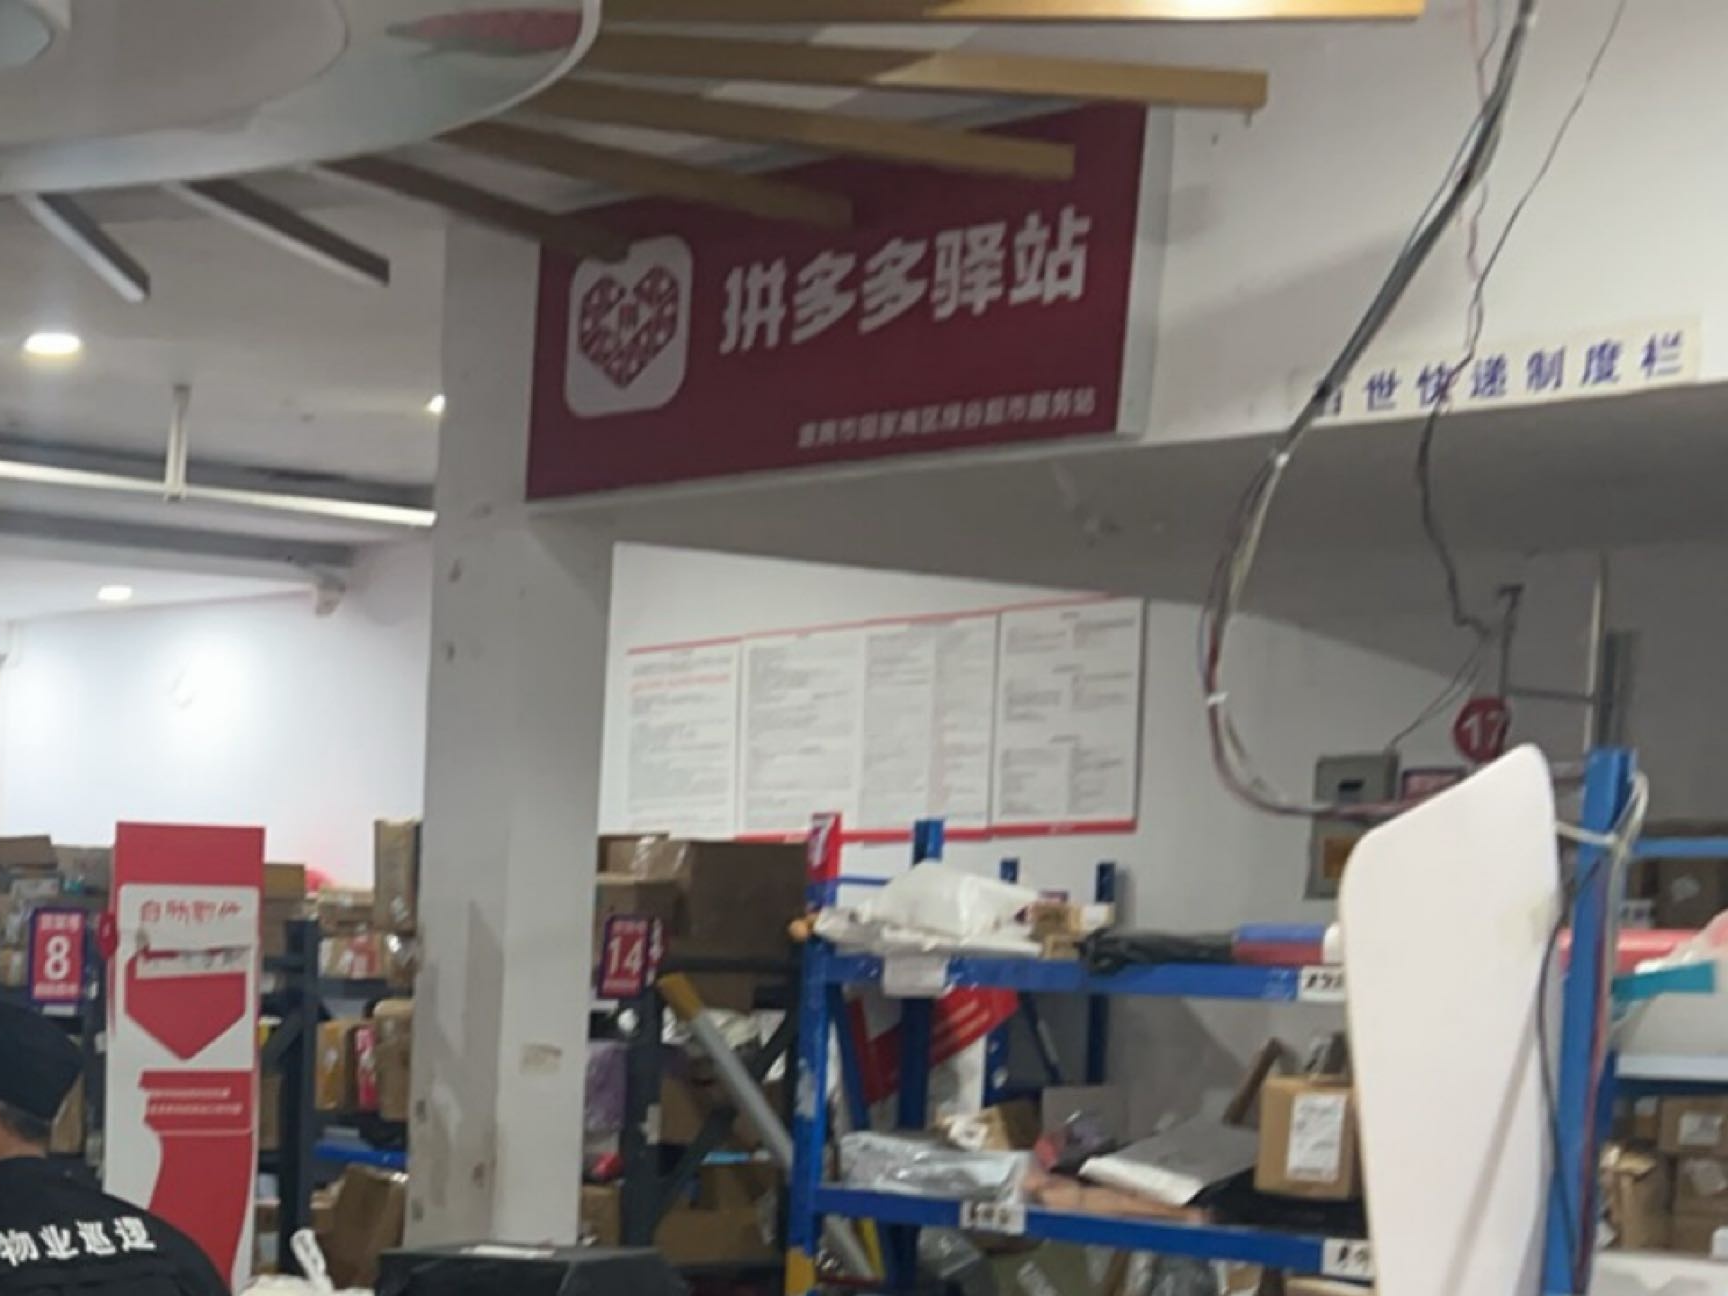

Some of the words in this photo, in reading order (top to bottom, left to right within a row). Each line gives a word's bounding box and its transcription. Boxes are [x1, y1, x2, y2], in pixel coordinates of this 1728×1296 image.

[719, 204, 1092, 354] 拼多多驿站
[1315, 330, 1683, 416] 世快递制度栏
[45, 934, 71, 981] 8
[608, 935, 643, 976] 14
